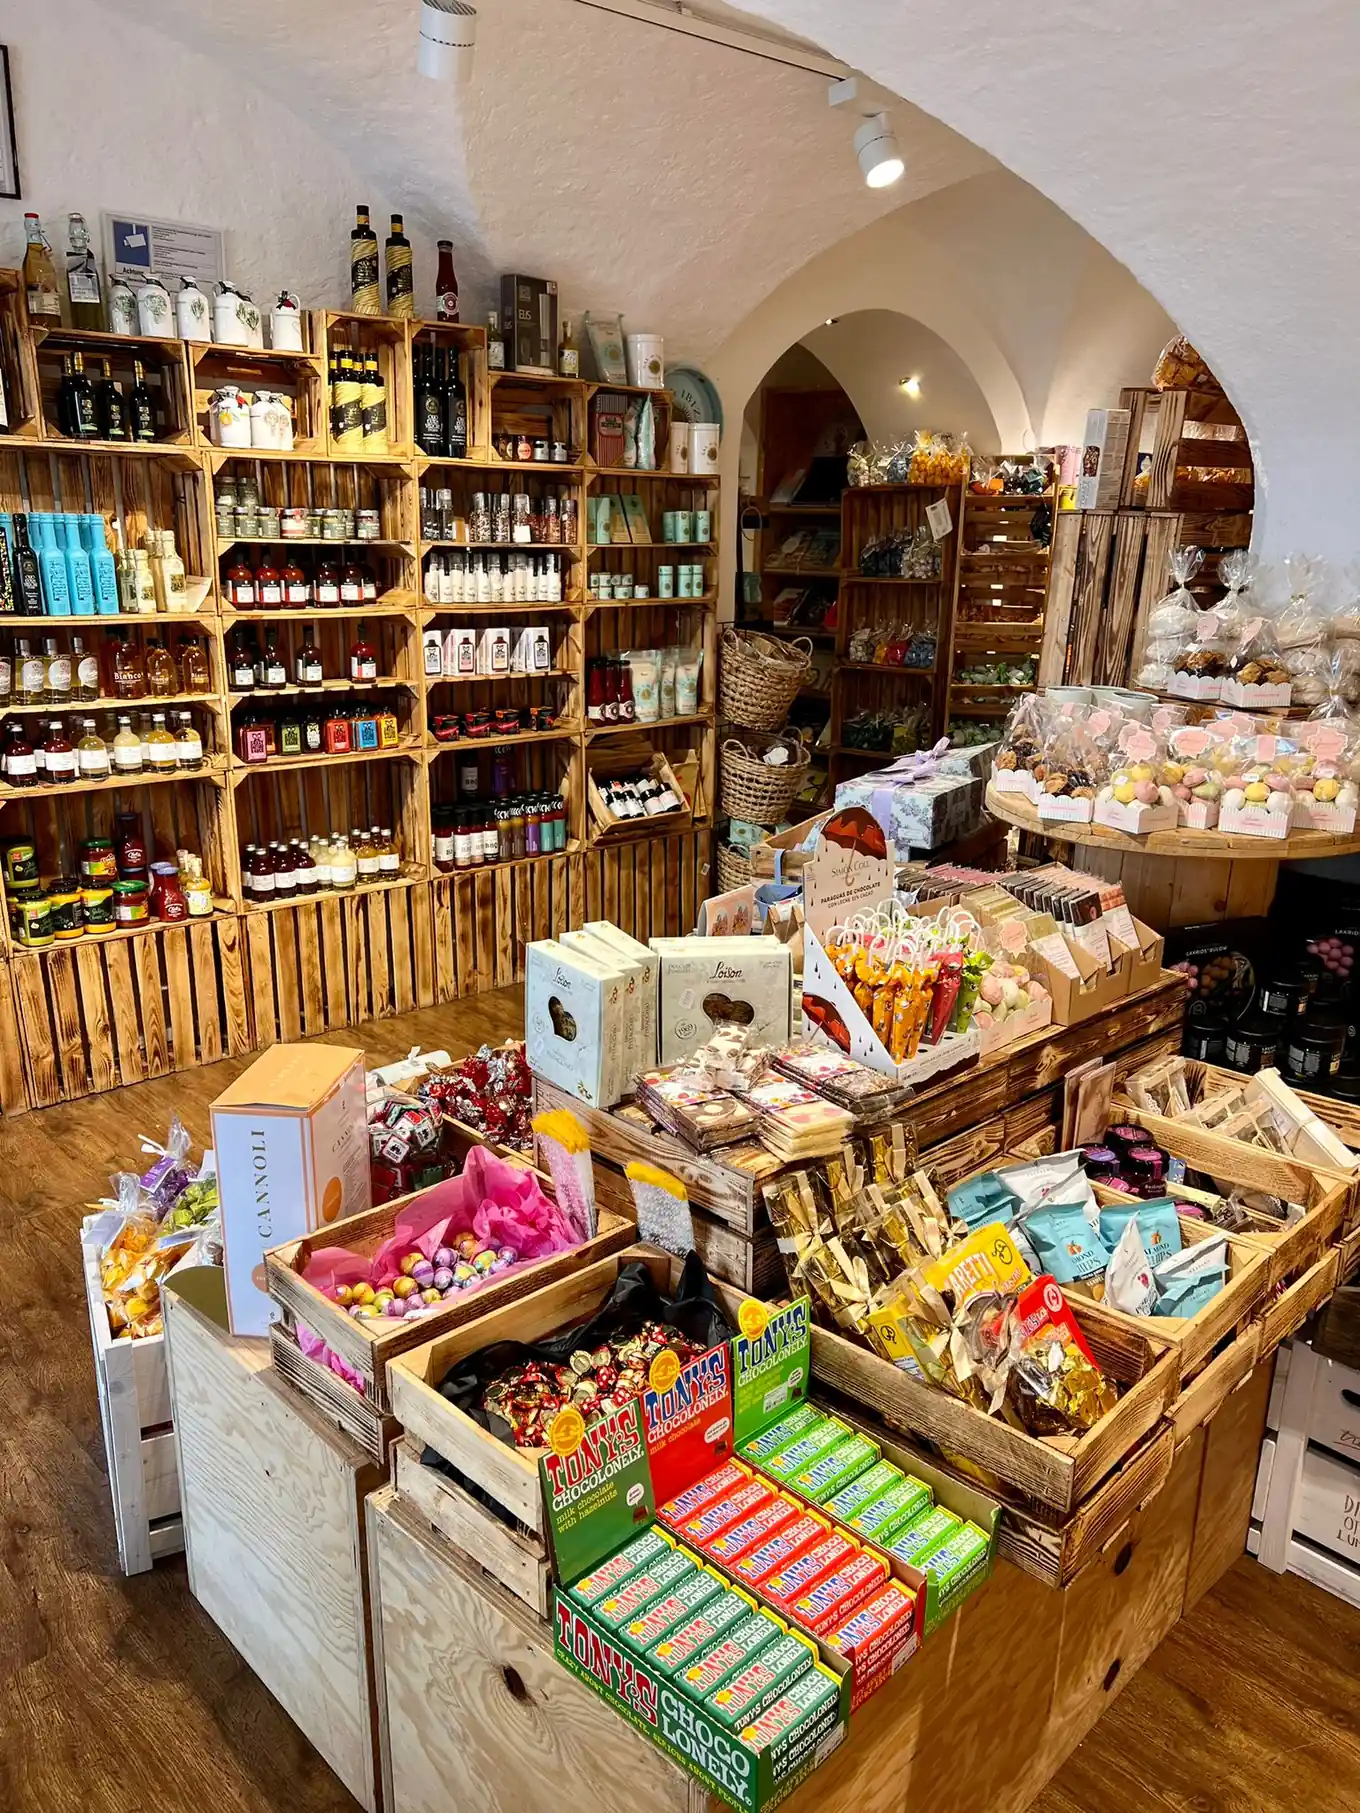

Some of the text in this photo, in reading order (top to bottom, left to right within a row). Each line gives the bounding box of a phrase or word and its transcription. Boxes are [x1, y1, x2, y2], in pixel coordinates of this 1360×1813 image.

[1336, 928, 1360, 937] LAKRID
[709, 961, 744, 979] Loison
[251, 1130, 274, 1238] CANNOLI
[738, 1302, 806, 1374] TONY'S
[644, 1347, 726, 1430] TONY'S
[543, 1403, 641, 1498] TONY'S
[556, 1507, 576, 1525] milk
[577, 1481, 615, 1510] chocolate
[558, 1516, 578, 1534] with
[578, 1489, 619, 1519] hazelnuts
[576, 1531, 658, 1600] TONY'S CHOCO
[602, 1552, 684, 1622] TONY'S CHOCO
[627, 1573, 711, 1645] TONY'S CHOCO
[655, 1592, 738, 1668] TONY'S CHOCO
[556, 1596, 750, 1778] TONY'S CHOCO
[683, 1614, 767, 1692] TONY'S CHOCO
[713, 1635, 796, 1716] TONY'S CHOCO
[761, 1656, 813, 1707] CHOCOLONELY
[741, 1695, 803, 1754] TONY'S
[788, 1671, 823, 1701] CHOCO
